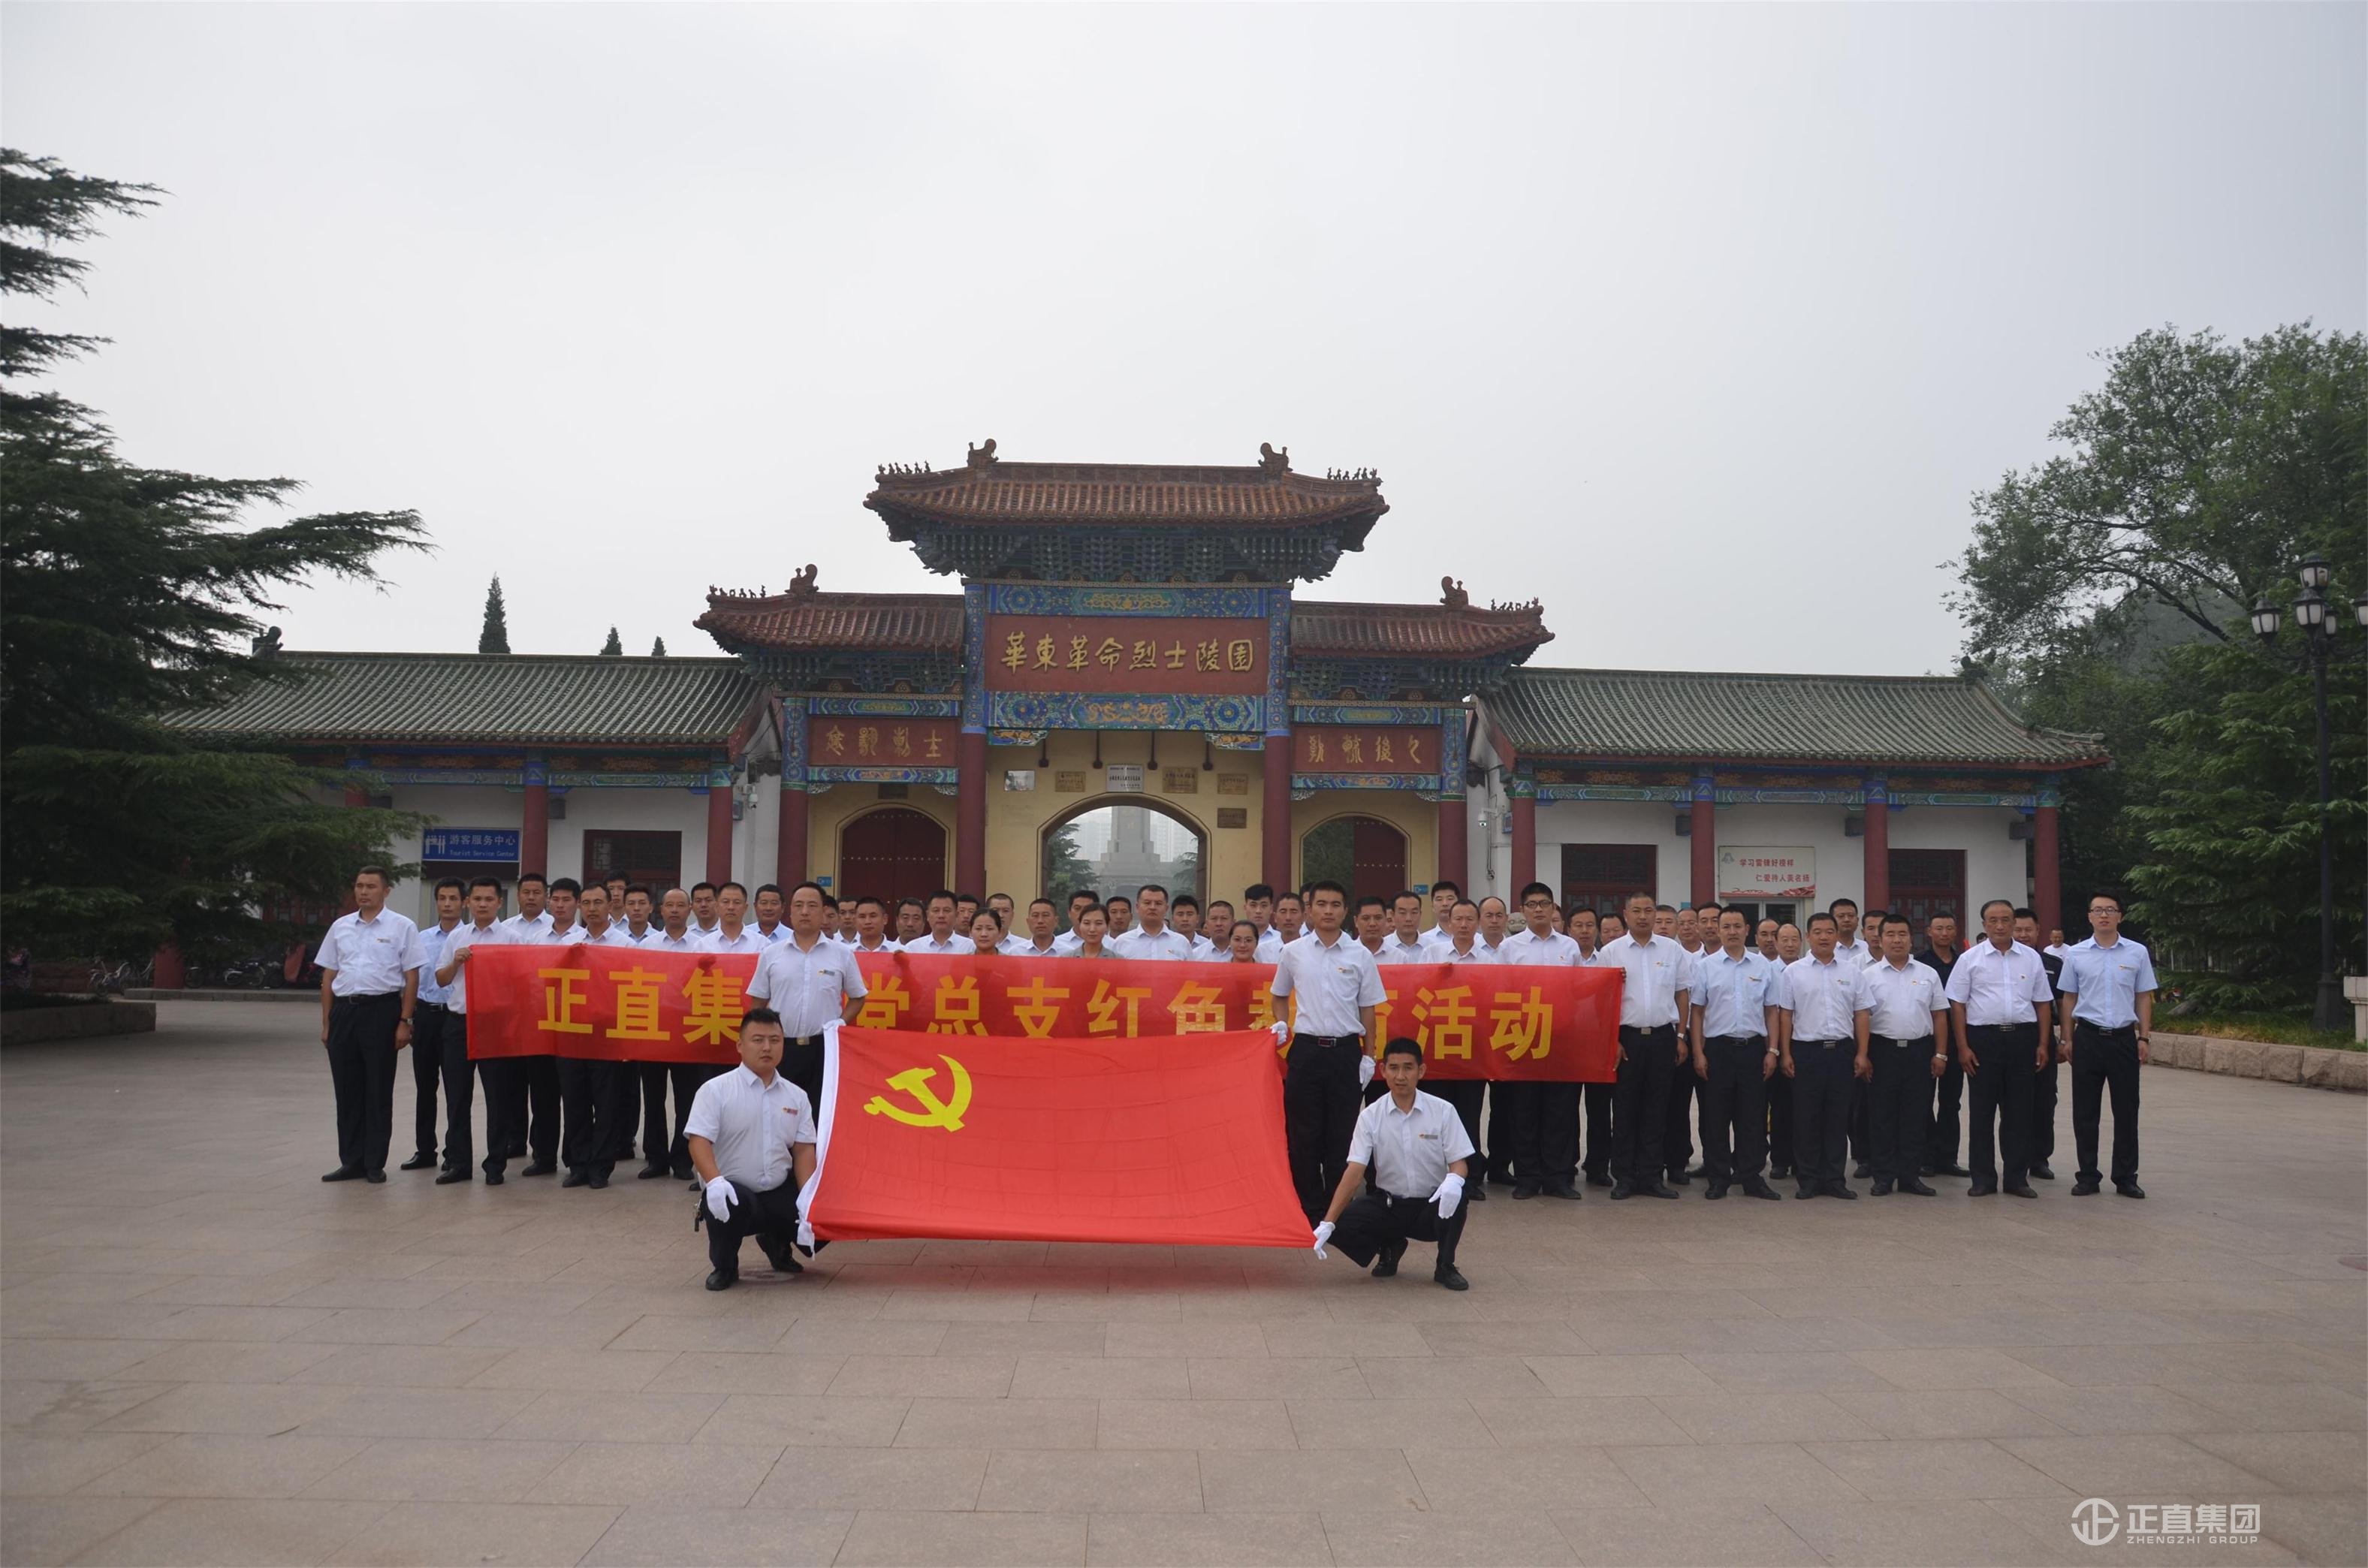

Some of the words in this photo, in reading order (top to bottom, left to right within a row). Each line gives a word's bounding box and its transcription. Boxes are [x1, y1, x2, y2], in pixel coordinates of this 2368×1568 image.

[449, 834, 516, 846] 游客服务中心
